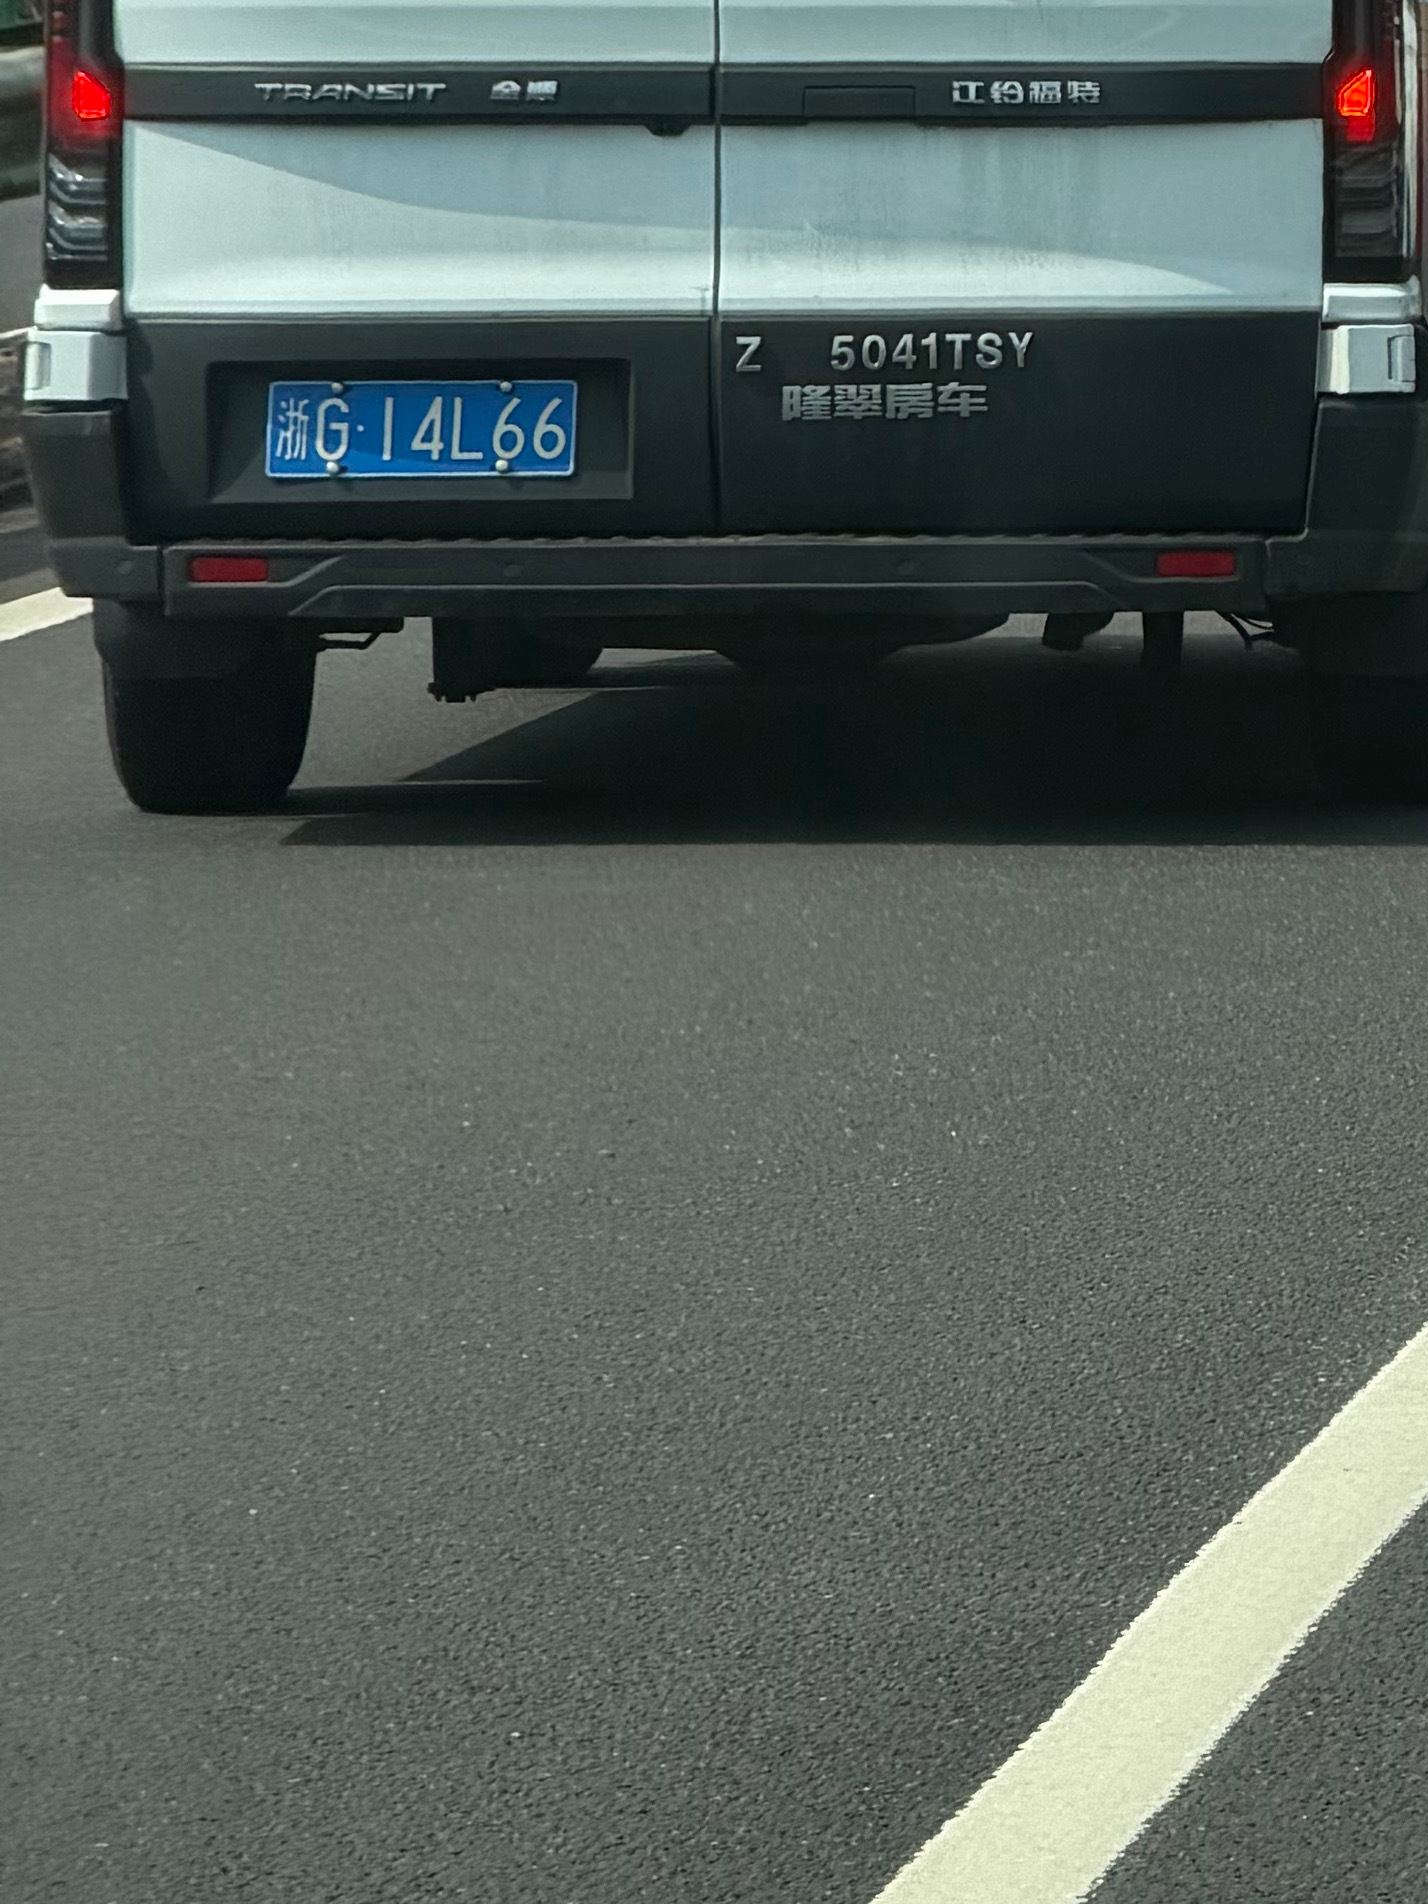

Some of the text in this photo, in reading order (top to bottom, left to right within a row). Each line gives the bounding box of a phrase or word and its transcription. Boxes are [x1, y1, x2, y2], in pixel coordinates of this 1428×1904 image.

[254, 83, 447, 101] TRANSIT
[952, 80, 1101, 104] 江铃福特
[736, 331, 1033, 372] Z 5041TSY
[782, 381, 989, 421] 隆翠房车
